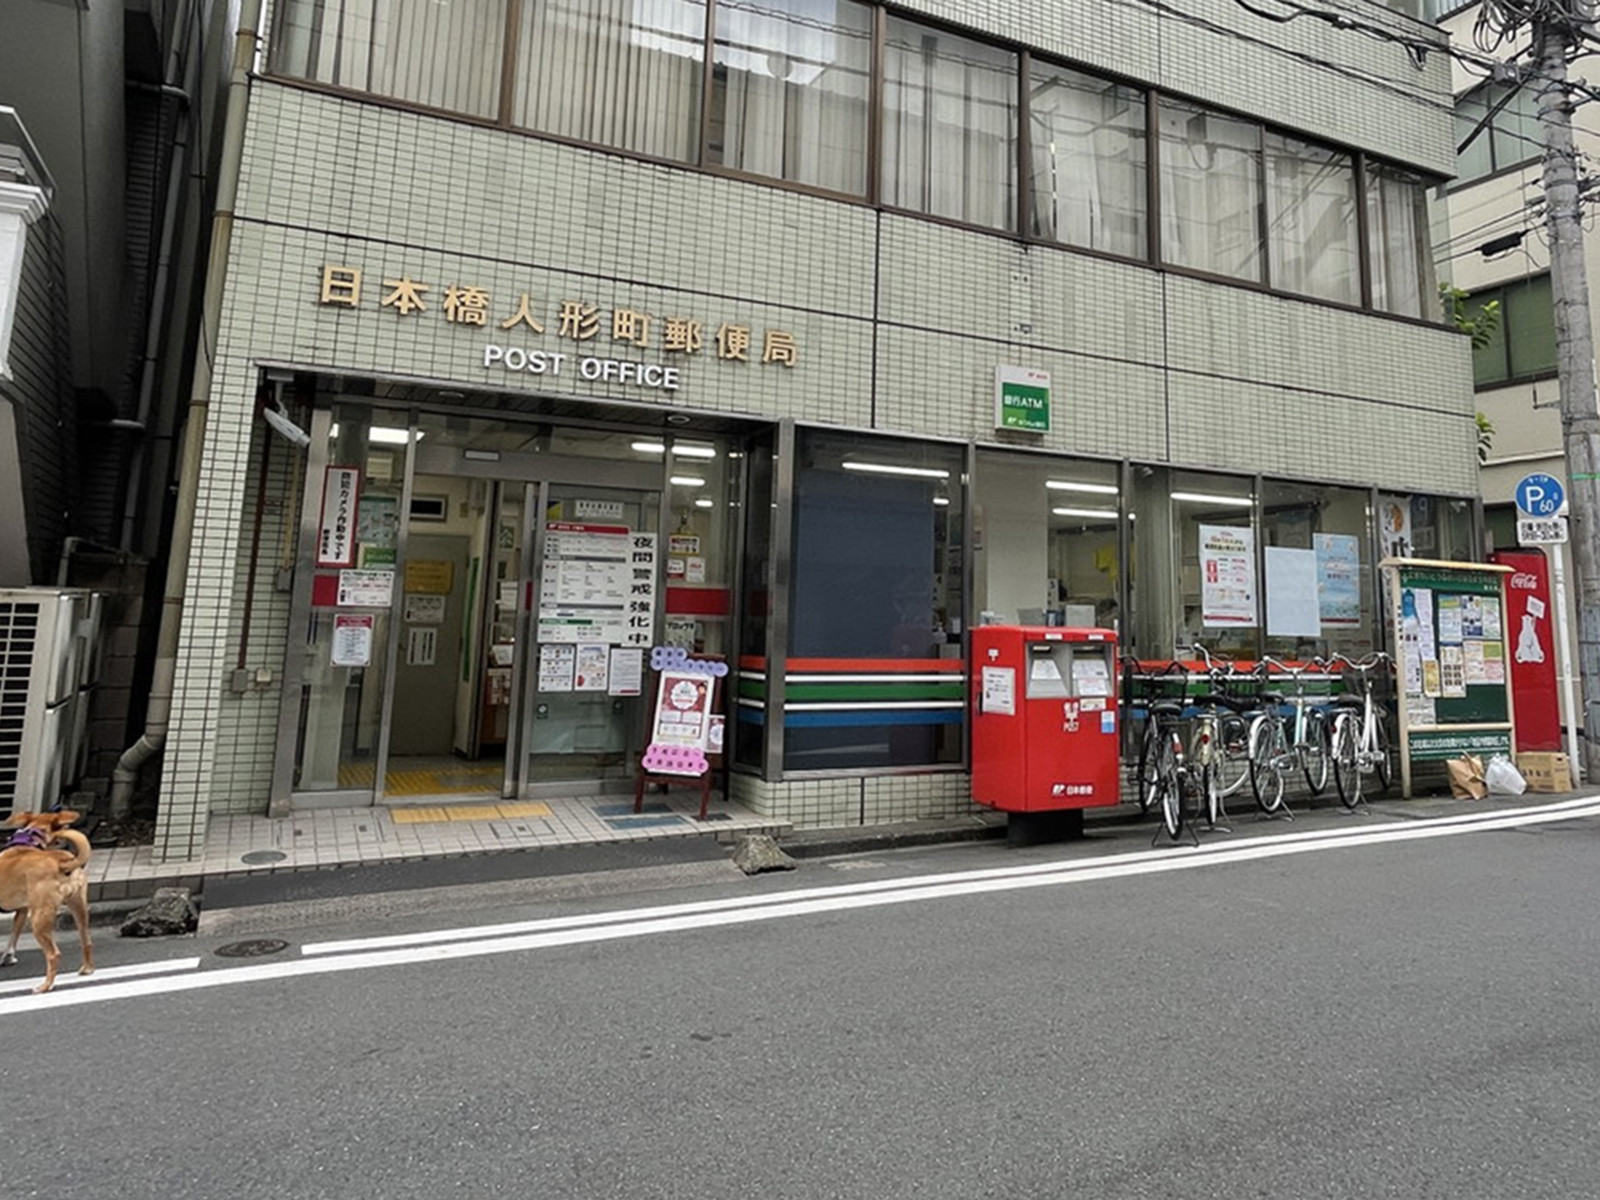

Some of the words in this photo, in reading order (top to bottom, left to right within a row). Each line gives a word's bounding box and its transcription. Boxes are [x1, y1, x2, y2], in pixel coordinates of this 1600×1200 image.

[320, 265, 798, 367] 日本橋人形町郵便局
[484, 344, 565, 376] POST
[581, 356, 680, 391] OFFICE
[1525, 485, 1545, 513] P
[1540, 499, 1554, 513] 60
[628, 536, 654, 644] 夜間警戒強化中
